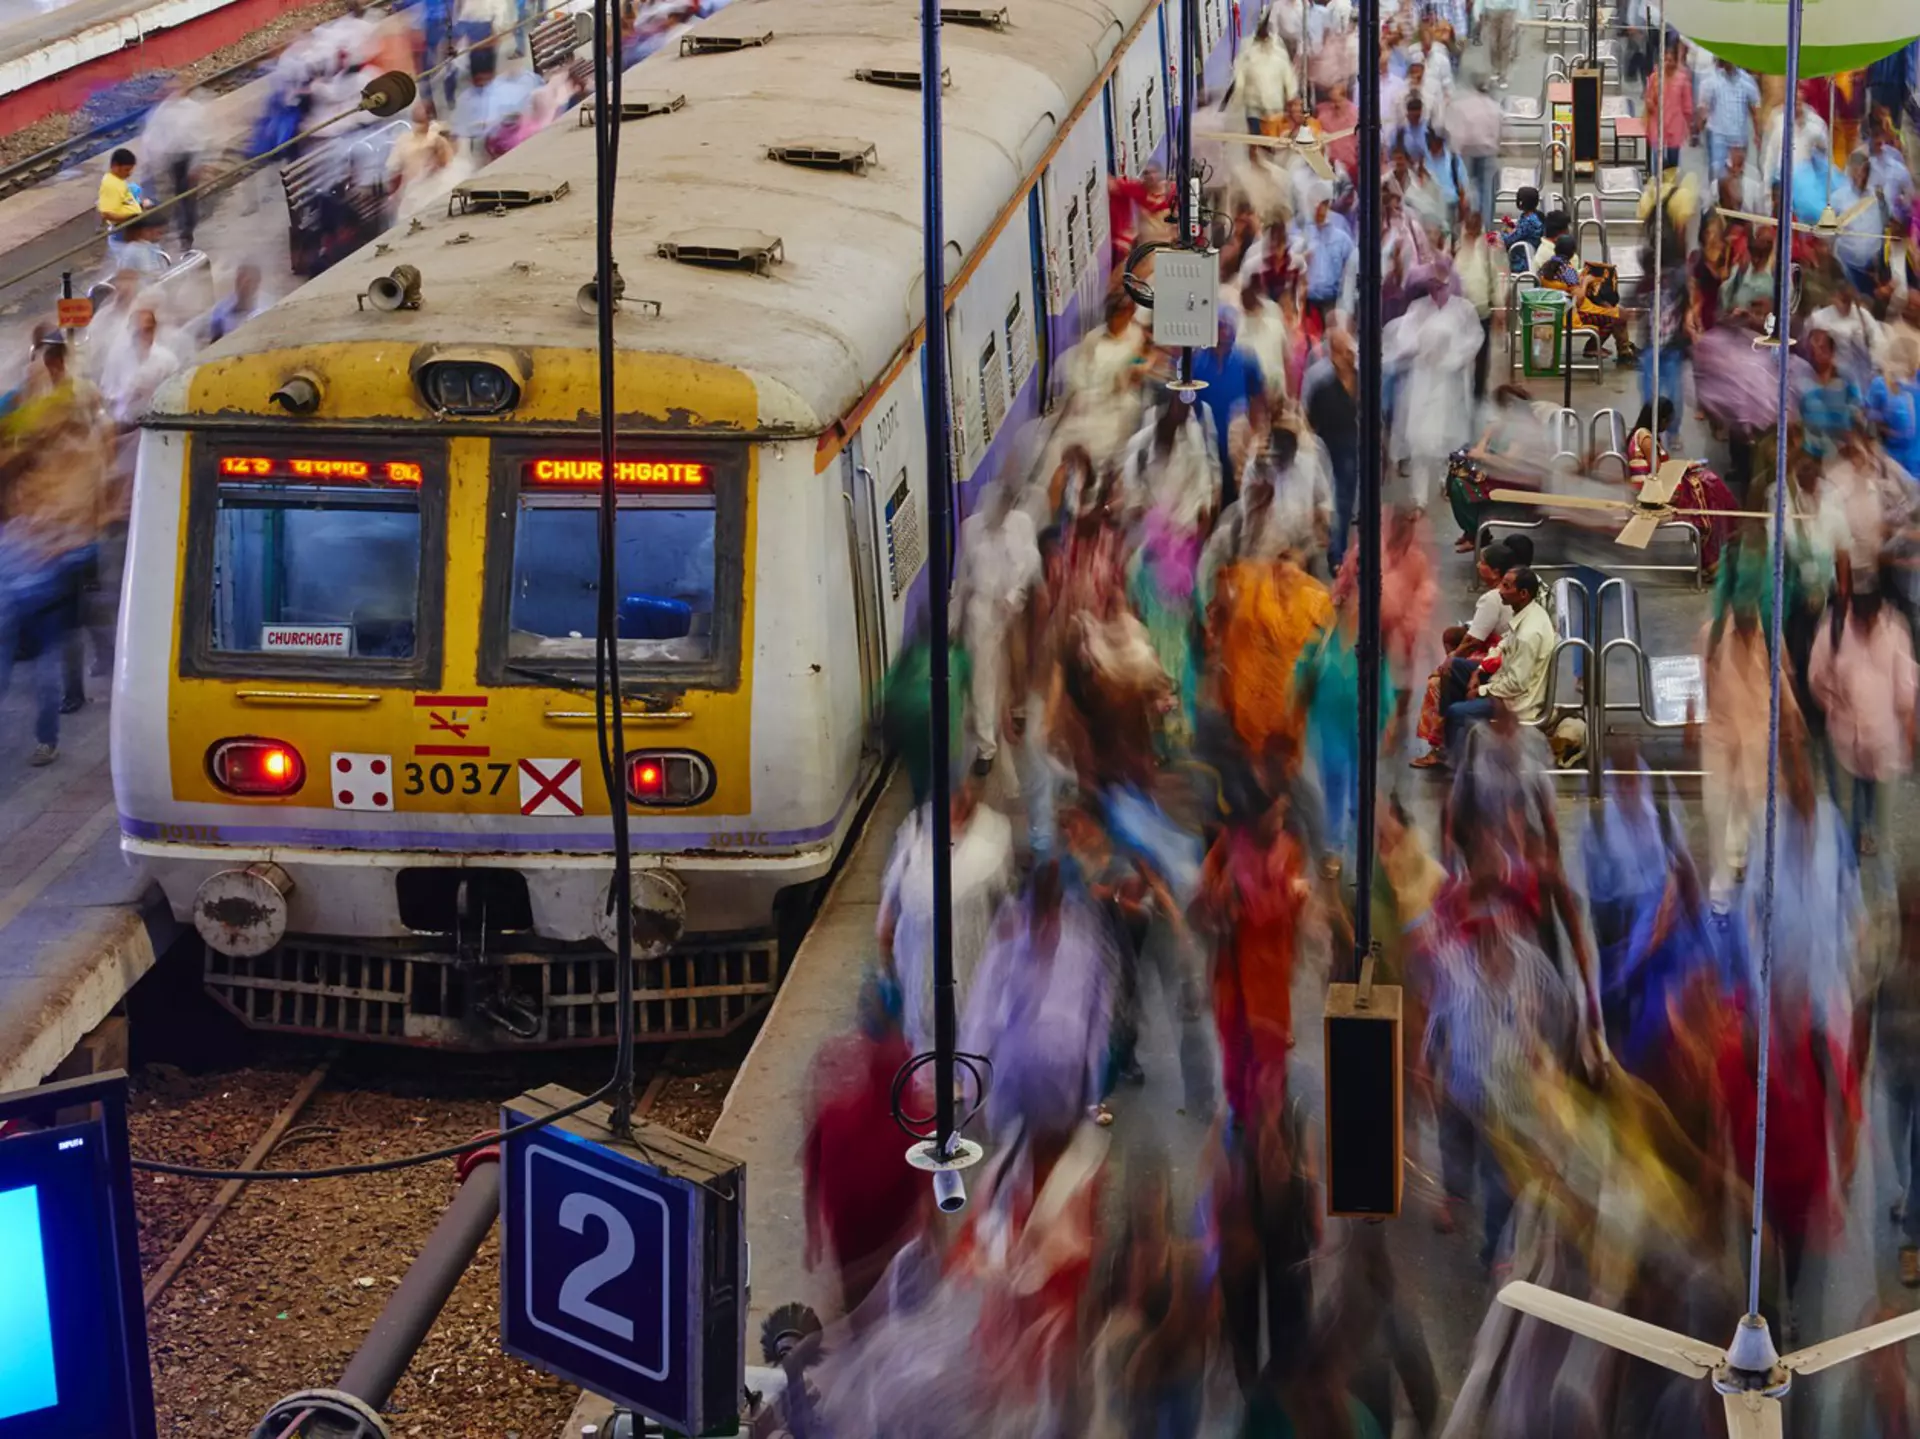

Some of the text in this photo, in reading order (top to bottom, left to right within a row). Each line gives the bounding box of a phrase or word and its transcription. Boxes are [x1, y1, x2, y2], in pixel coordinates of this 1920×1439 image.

[268, 632, 343, 645] CHURCHGATE
[404, 763, 512, 795] 3037
[559, 1192, 635, 1342] 2
